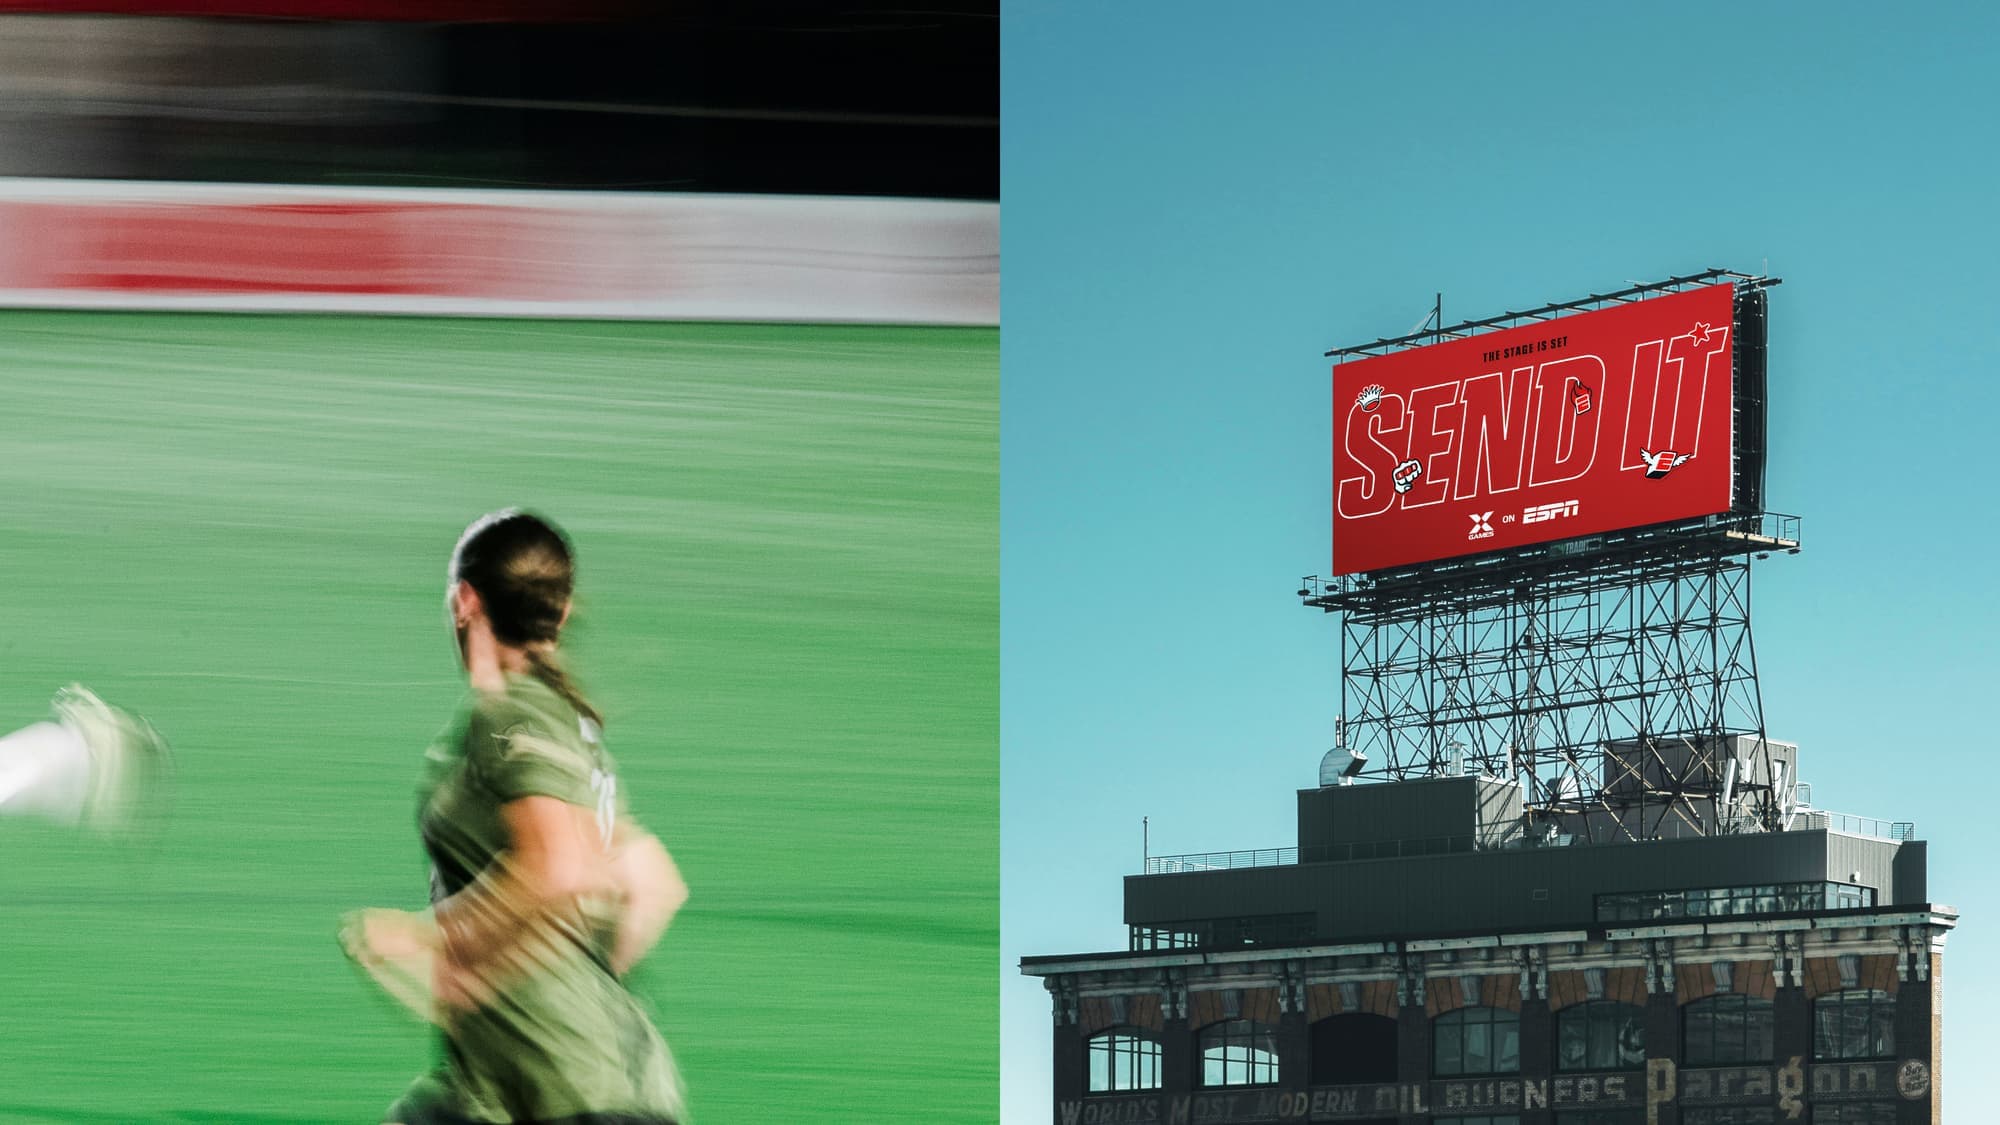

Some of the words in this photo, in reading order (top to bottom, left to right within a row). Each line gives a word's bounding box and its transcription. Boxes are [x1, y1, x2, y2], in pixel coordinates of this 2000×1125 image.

[1483, 350, 1500, 362] THE
[1504, 343, 1534, 359] STAGE
[1537, 340, 1547, 352] IS
[1550, 336, 1567, 349] SET
[1338, 355, 1605, 518] SEND
[1620, 326, 1729, 471] IT
[1468, 511, 1494, 534] X
[1502, 514, 1515, 524] ON
[1523, 500, 1579, 524] ESPN
[1468, 531, 1494, 540] GAMES
[1060, 1098, 1160, 1125] WORLD'S
[1169, 1096, 1239, 1125] MOST
[1257, 1089, 1358, 1117] MODERN
[1375, 1084, 1429, 1114] OIL
